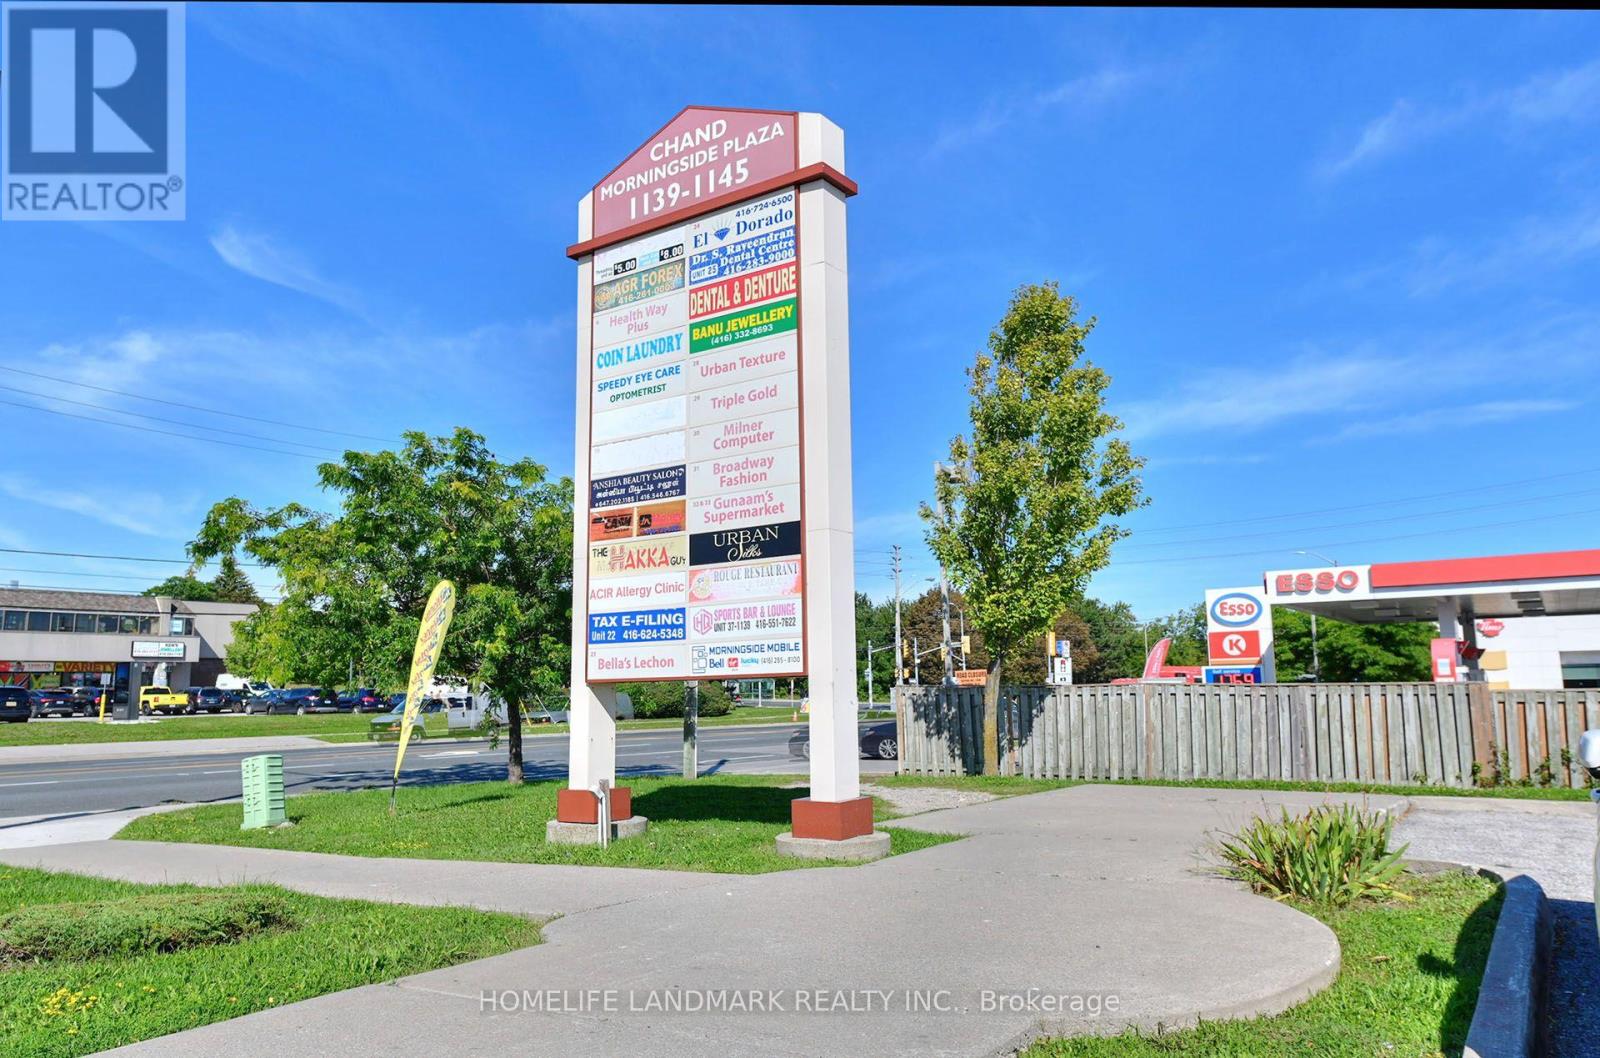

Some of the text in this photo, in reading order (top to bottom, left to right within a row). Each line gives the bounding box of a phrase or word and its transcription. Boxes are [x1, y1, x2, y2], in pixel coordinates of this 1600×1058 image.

[650, 119, 727, 161] CHAND
[600, 121, 784, 200] MORNINGSIDE PLAZA
[630, 158, 749, 220] 1139-1145
[693, 208, 793, 249] El Dorado
[660, 246, 683, 260] $8.00
[692, 228, 794, 266] Dr. S. Raveendran
[720, 240, 794, 267] Dental Centre
[614, 259, 636, 273] $5.00
[723, 248, 794, 277] 416-283-9000
[613, 277, 638, 297] AGR
[641, 262, 683, 289] FOREX
[692, 269, 706, 280] UNIT
[690, 265, 796, 316] DENTAL & DENTURE
[609, 303, 668, 327] Health Way
[692, 305, 793, 341] BANU JEWELLERY
[627, 321, 649, 335] Plus
[711, 323, 773, 346] (416) 332-8693
[596, 333, 683, 369] COIN LAUNDRY
[700, 350, 786, 377] Urban Texture
[597, 365, 681, 392] SPEEDY EYE CARE
[609, 383, 667, 403] OPTOMETRIST
[711, 384, 778, 410] Triple Gold
[723, 421, 763, 437] Milner
[713, 431, 775, 450] Computer
[713, 456, 774, 475] Broadway
[593, 469, 679, 490] ANSHIA BEAUTY SALON
[720, 471, 767, 488] Fashion
[713, 490, 774, 510] Gunaam's
[704, 502, 785, 524] Supermarket
[713, 526, 779, 547] URBAN
[592, 547, 608, 558] THE
[609, 545, 670, 573] HAKKA
[670, 556, 686, 566] GUY
[727, 543, 762, 562] Silks
[713, 563, 797, 582] ROUGE RESTAURANT
[1276, 570, 1359, 593] ESSO
[590, 582, 684, 600] ACIR Allergy Clinic
[714, 603, 796, 621] SPORTS BAR & LOUNGE
[1219, 602, 1255, 616] Esso
[592, 613, 684, 628] TAX E-FILING
[713, 622, 726, 633] UNIT
[592, 628, 684, 641] Unit 22 416-624-5348
[709, 642, 800, 655] MORNINGSIDE MOBILE
[1228, 639, 1244, 653] K
[64, 661, 116, 673] VARIETY
[598, 656, 675, 670] Bella's Lechon
[709, 658, 724, 669] Bell
